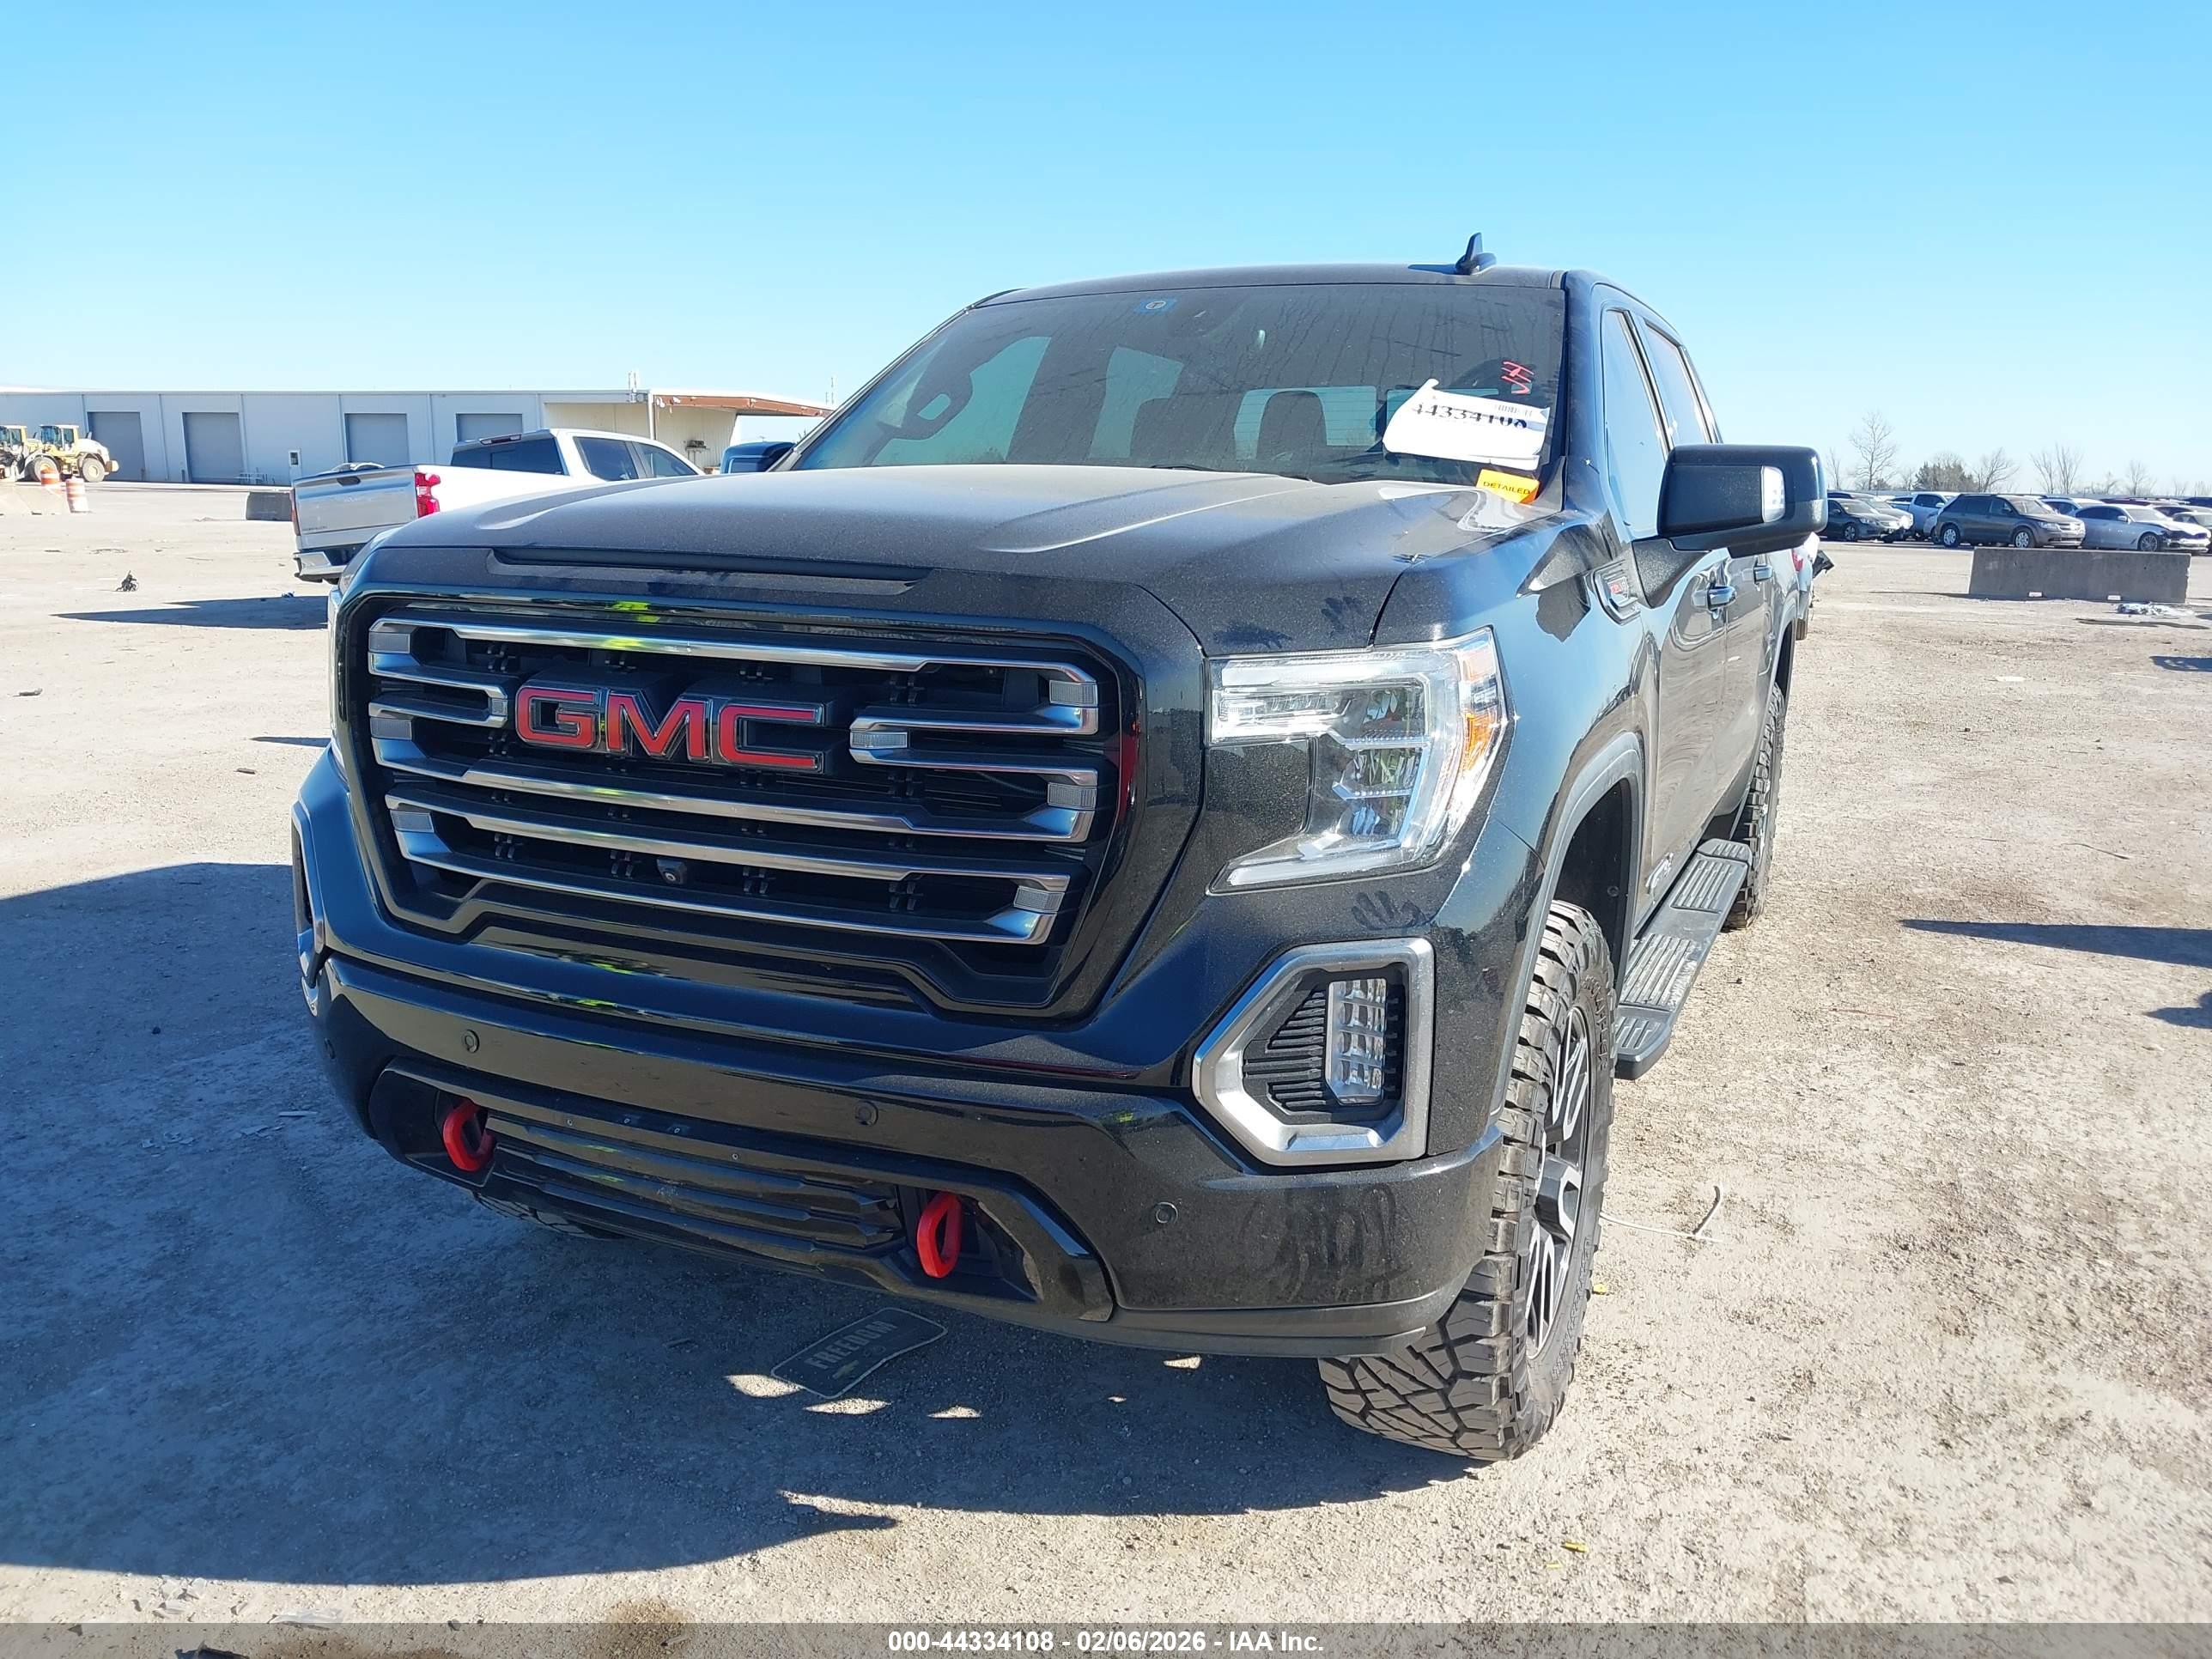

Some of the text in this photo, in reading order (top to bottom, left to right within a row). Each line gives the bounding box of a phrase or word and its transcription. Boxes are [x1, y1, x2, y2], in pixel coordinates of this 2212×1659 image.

[1483, 481, 1531, 495] DETAILED
[515, 684, 826, 774] GMC
[804, 1320, 898, 1370] FREEDOM
